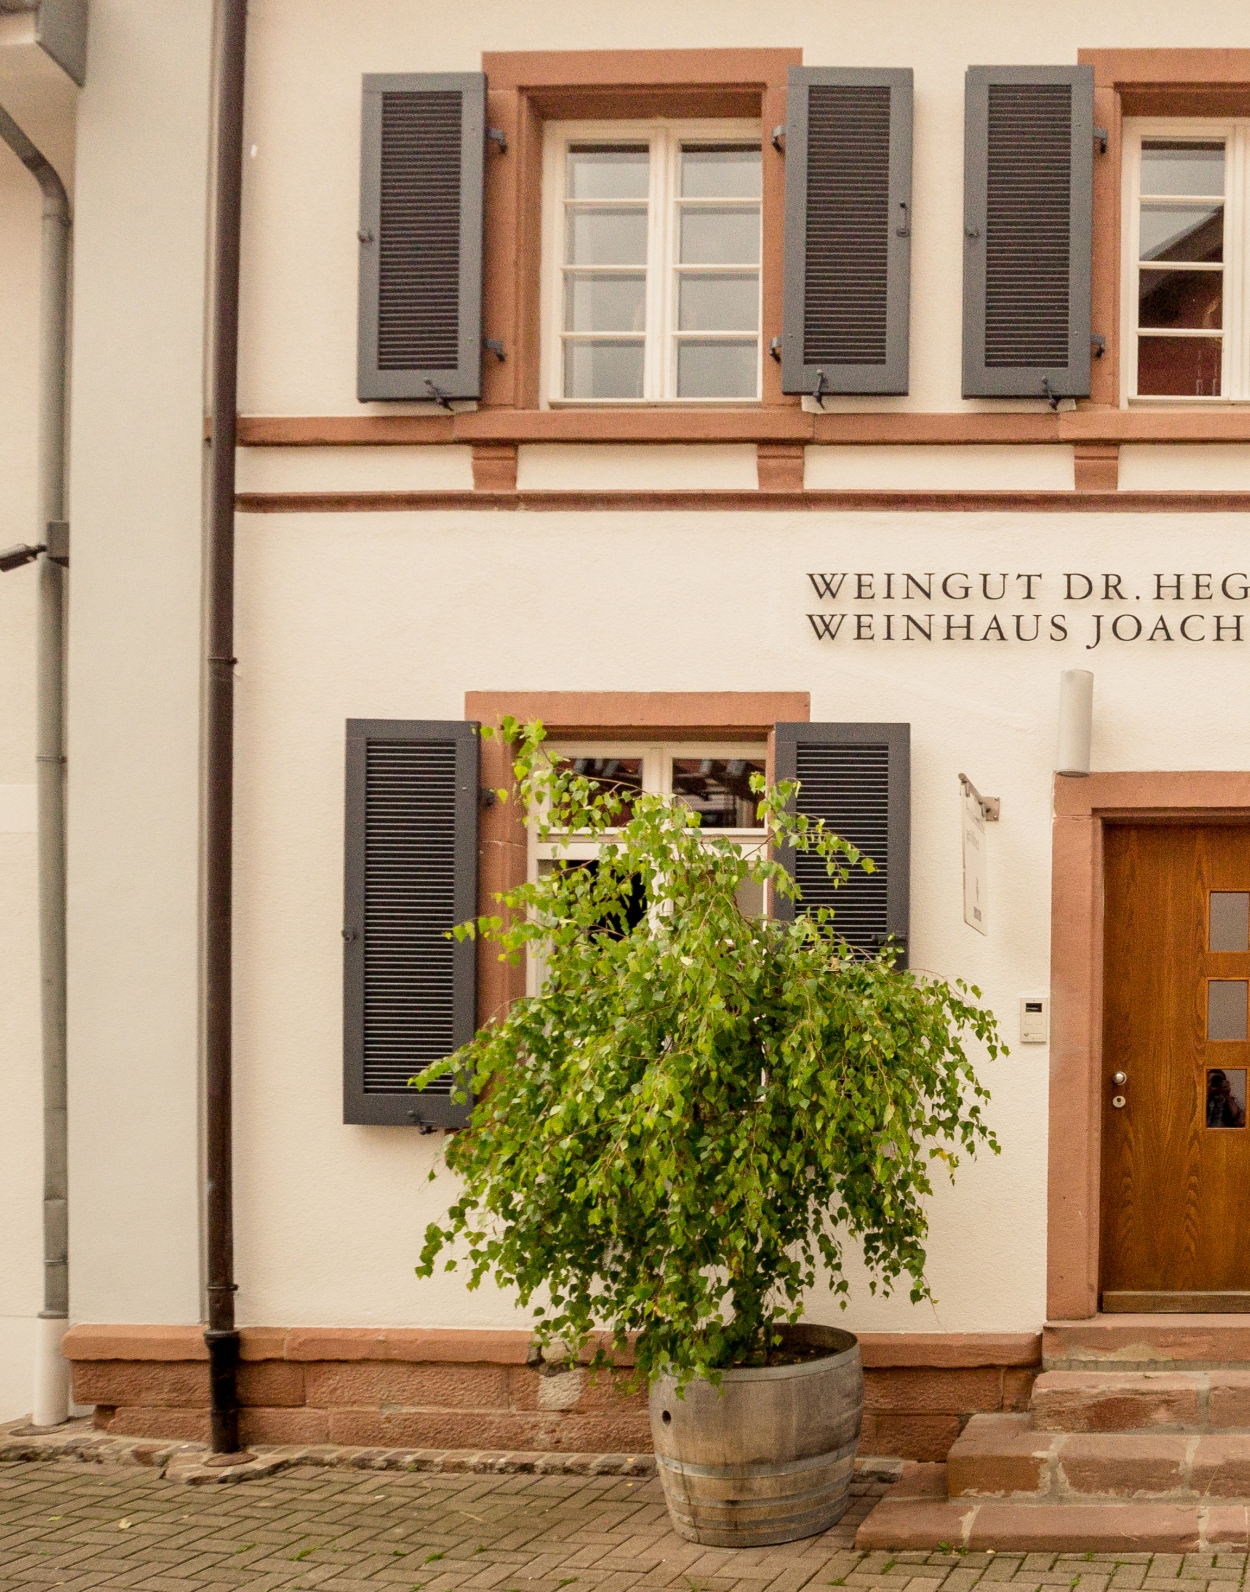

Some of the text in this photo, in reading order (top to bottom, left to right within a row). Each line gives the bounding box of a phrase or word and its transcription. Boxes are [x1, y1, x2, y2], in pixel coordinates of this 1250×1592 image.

[806, 572, 1042, 600] WEINGUT
[1062, 573, 1141, 601] DR.
[806, 613, 1068, 642] WEINHAUS
